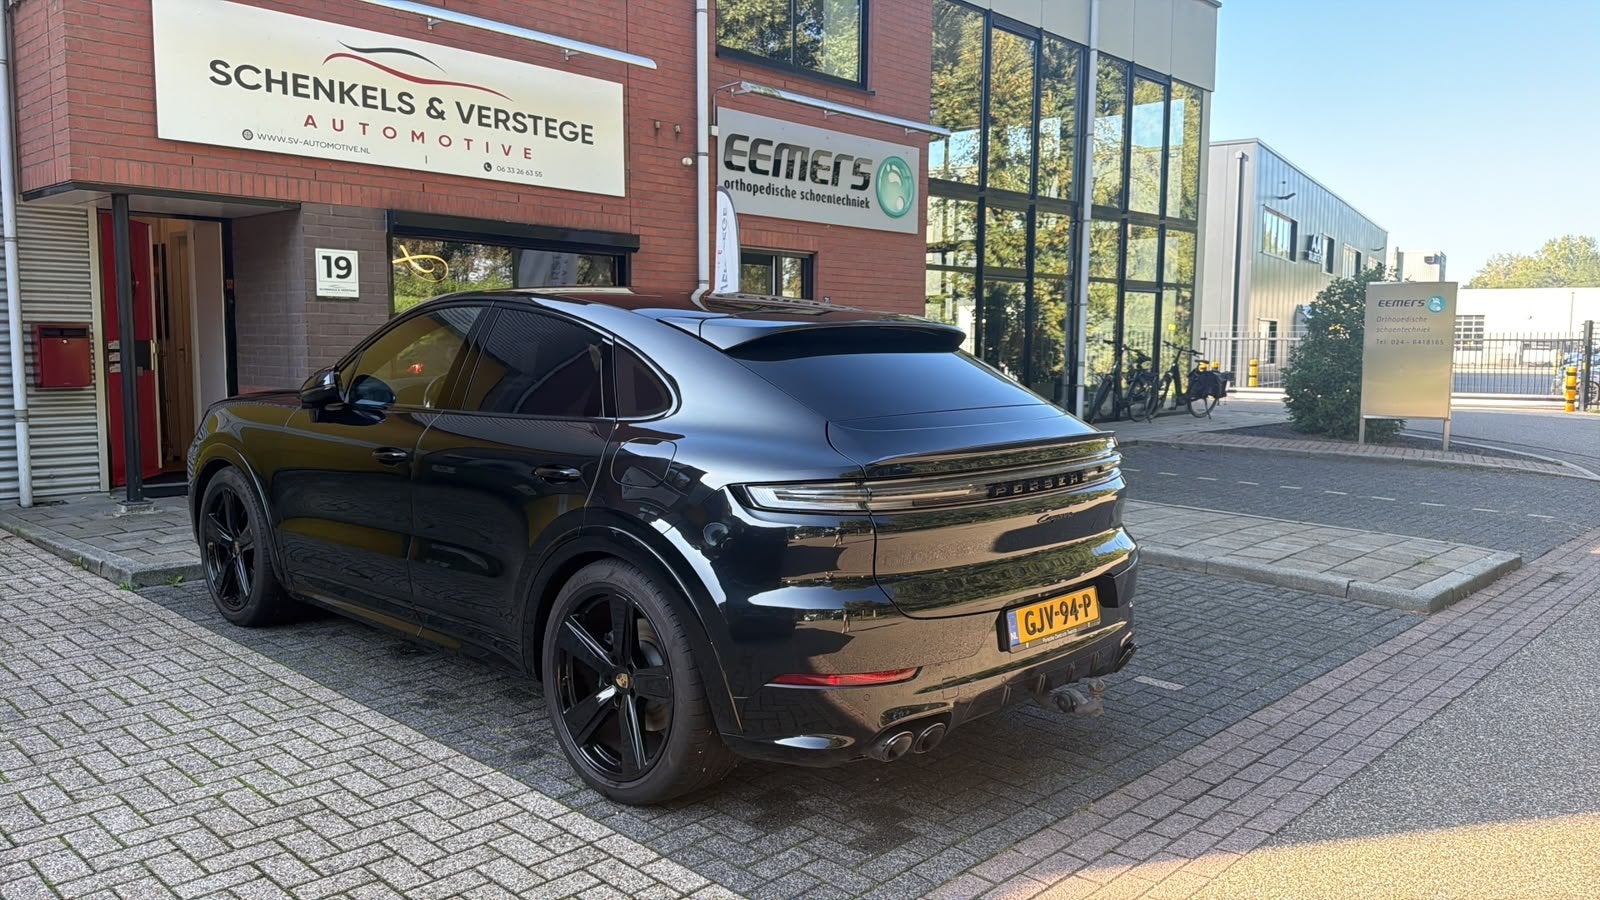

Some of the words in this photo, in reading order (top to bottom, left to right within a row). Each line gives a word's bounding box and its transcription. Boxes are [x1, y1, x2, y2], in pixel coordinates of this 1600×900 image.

[208, 59, 416, 115] SCHENKELS
[425, 96, 447, 121] &
[455, 101, 595, 145] VERSTEGE
[256, 132, 371, 155] WWW.SV-AUTOMOTIVE.NL
[303, 114, 533, 160] AUTOMOTIVE
[496, 165, 506, 173] 06
[506, 166, 515, 174] 33
[534, 170, 543, 178] 55
[723, 178, 797, 199] orthopedische
[800, 190, 871, 210] schoentechniek
[321, 255, 353, 279] 19
[1024, 593, 1092, 636] GJV-94-P
[1010, 632, 1018, 641] NL
